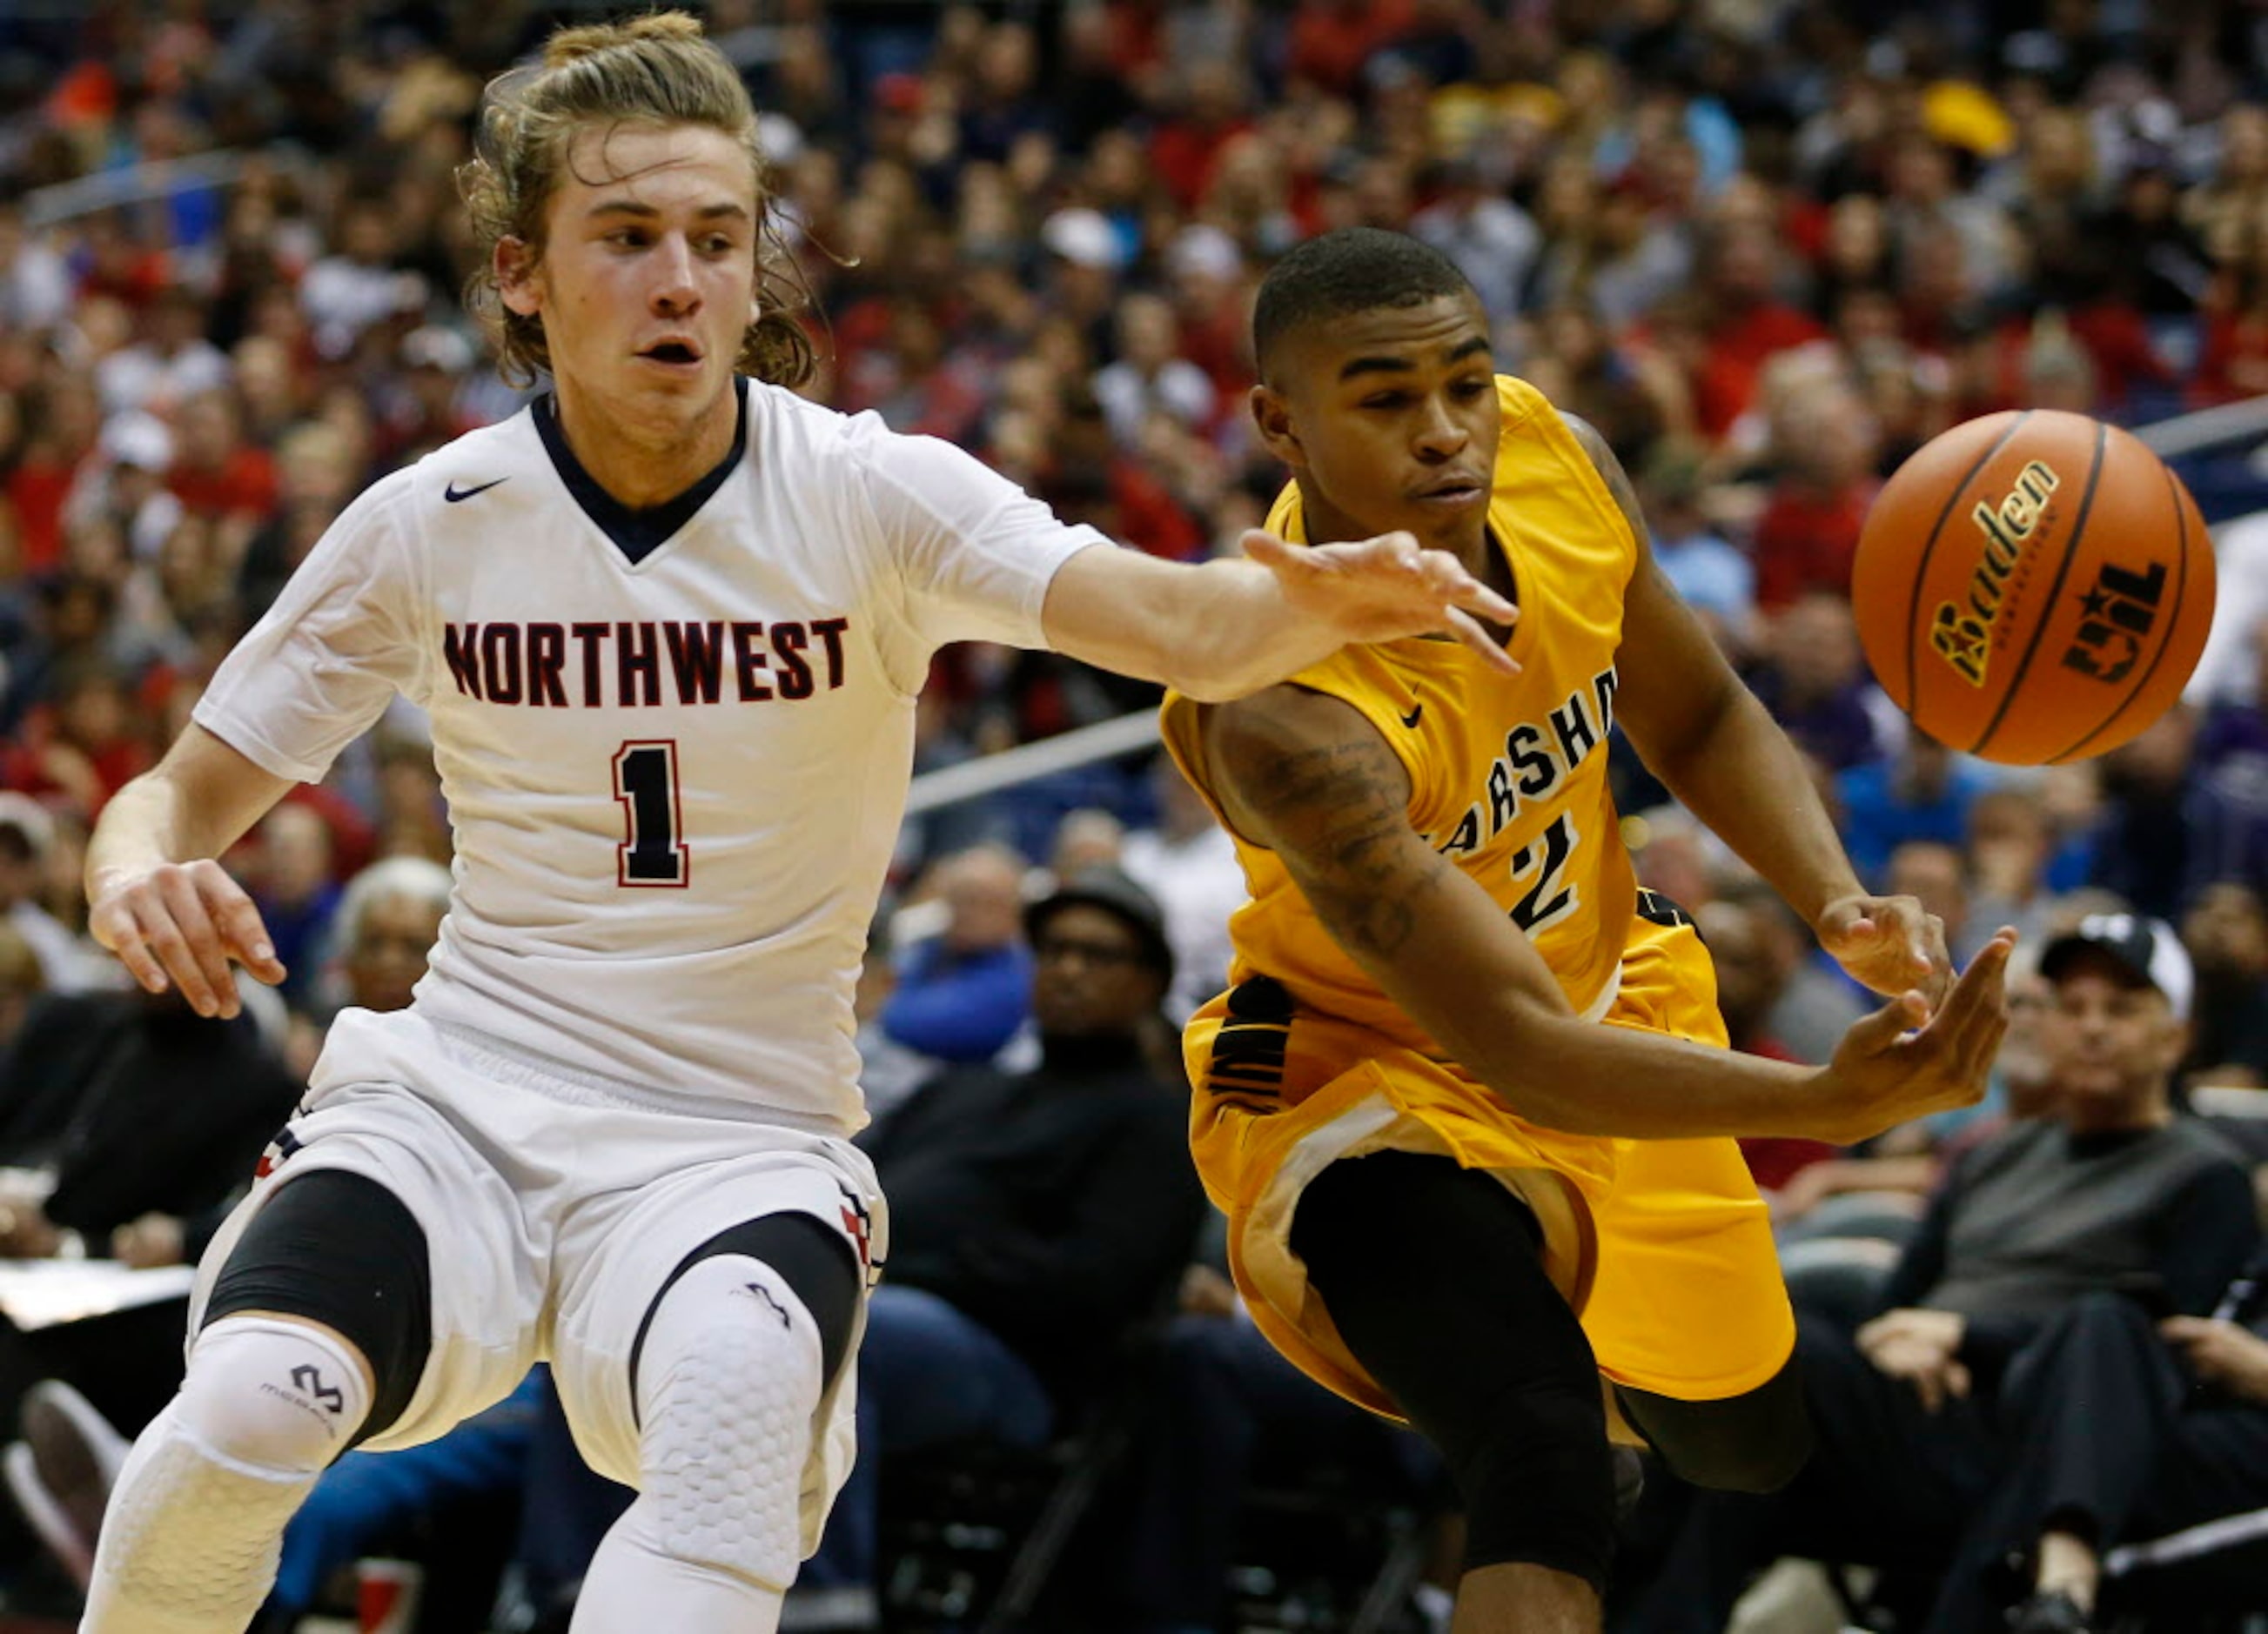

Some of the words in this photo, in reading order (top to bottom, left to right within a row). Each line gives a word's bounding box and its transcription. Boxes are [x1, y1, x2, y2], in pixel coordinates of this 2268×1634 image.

[1930, 459, 2061, 689] Baden
[443, 617, 849, 709] NORTHWEST
[611, 739, 690, 888] 1
[1507, 807, 1582, 941] 2
